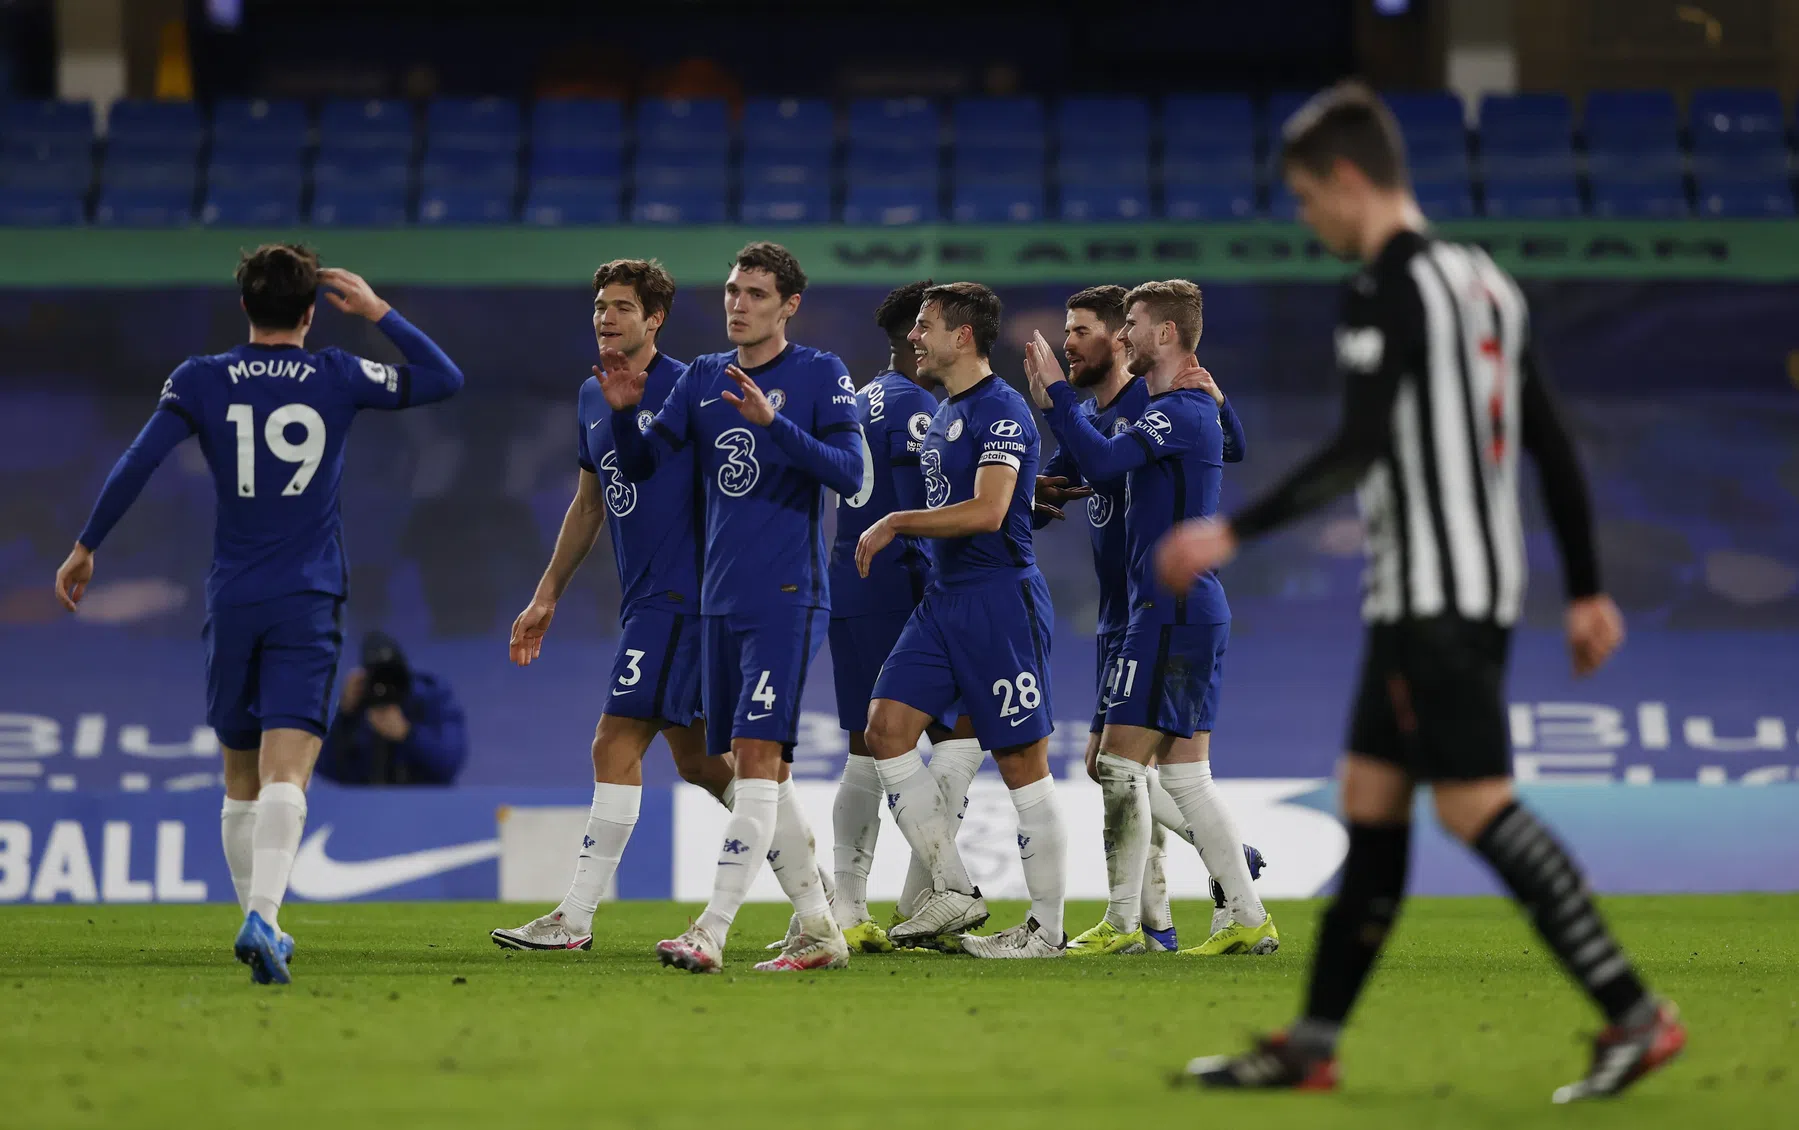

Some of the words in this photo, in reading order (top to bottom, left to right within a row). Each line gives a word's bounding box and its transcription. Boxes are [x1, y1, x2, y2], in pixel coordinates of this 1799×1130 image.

[228, 360, 316, 384] MOUNT
[226, 403, 327, 498] 19
[984, 441, 1026, 453] HYUNDAI
[1133, 420, 1166, 446] YUNDAI
[618, 649, 645, 686] 3
[1113, 657, 1138, 697] 11
[751, 670, 776, 710] 4
[992, 671, 1041, 718] 28
[0, 714, 220, 758] Blu
[1508, 701, 1799, 754] Blu
[0, 819, 208, 901] BALL
